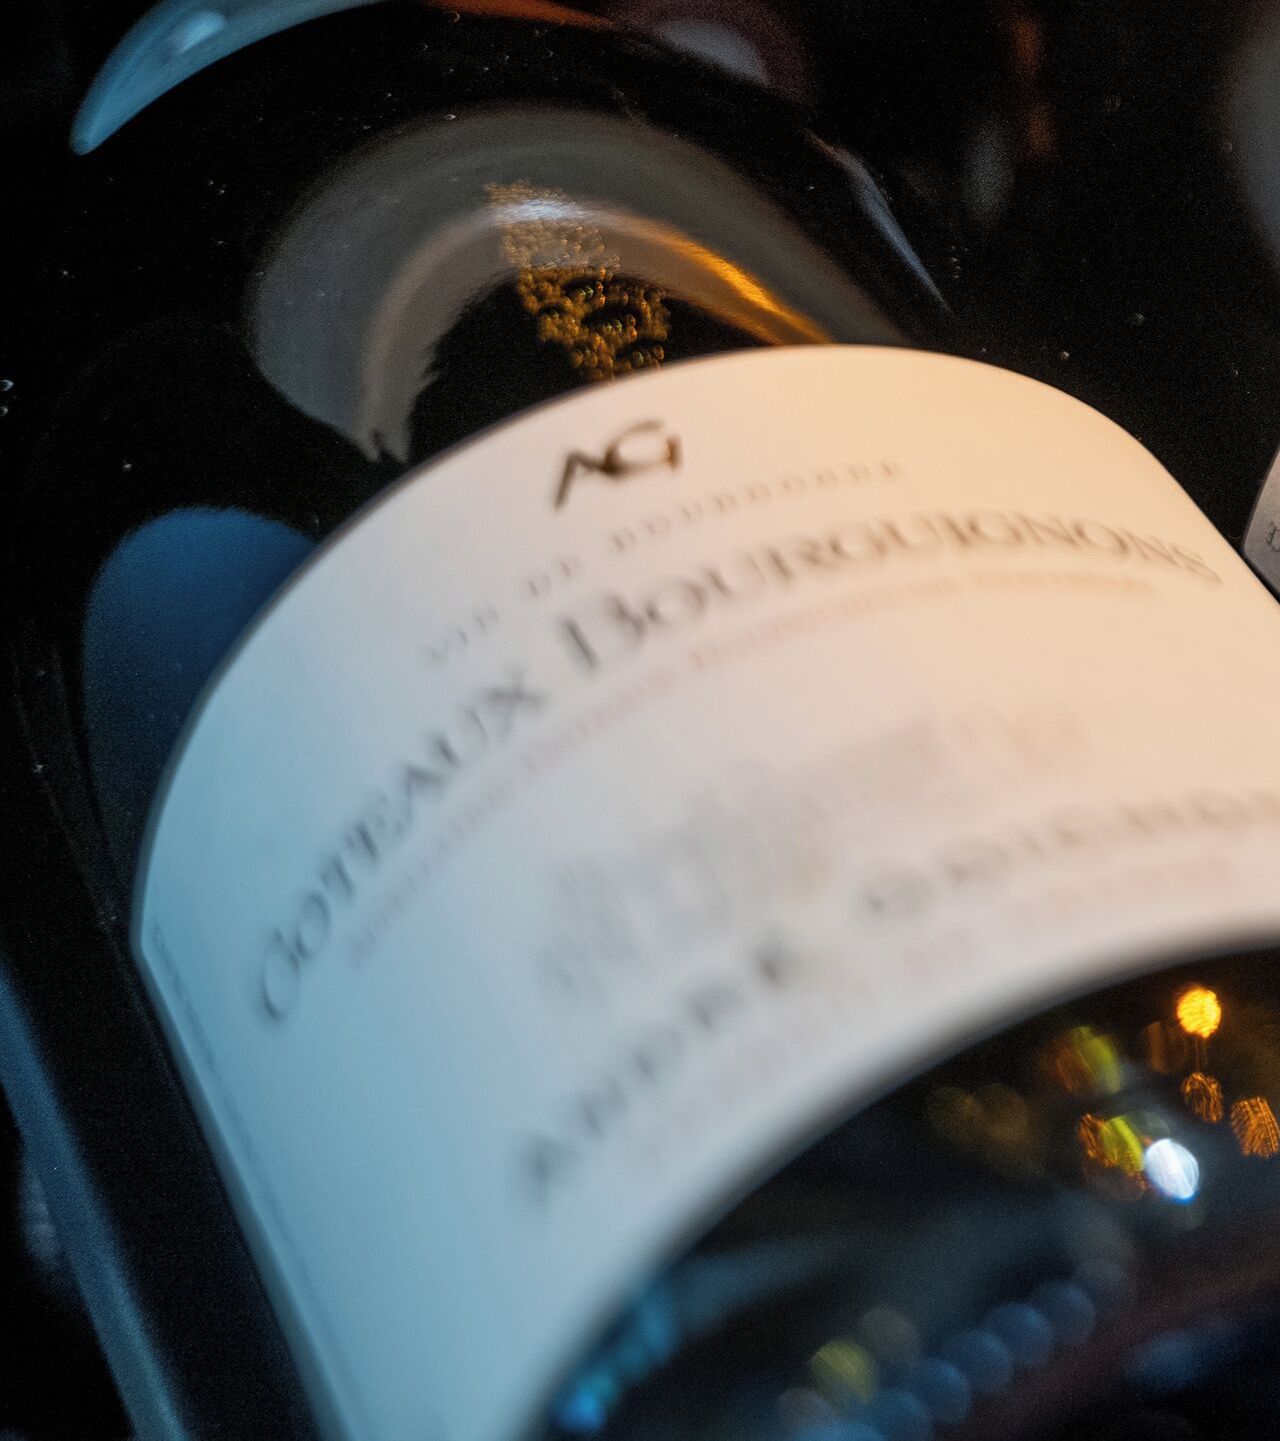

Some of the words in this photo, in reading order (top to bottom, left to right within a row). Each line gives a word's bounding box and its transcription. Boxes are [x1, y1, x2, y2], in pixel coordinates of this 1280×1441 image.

[552, 419, 682, 510] AG
[258, 664, 545, 1025] COTEAUX
[560, 505, 1222, 672] BOURGUIGNONS
